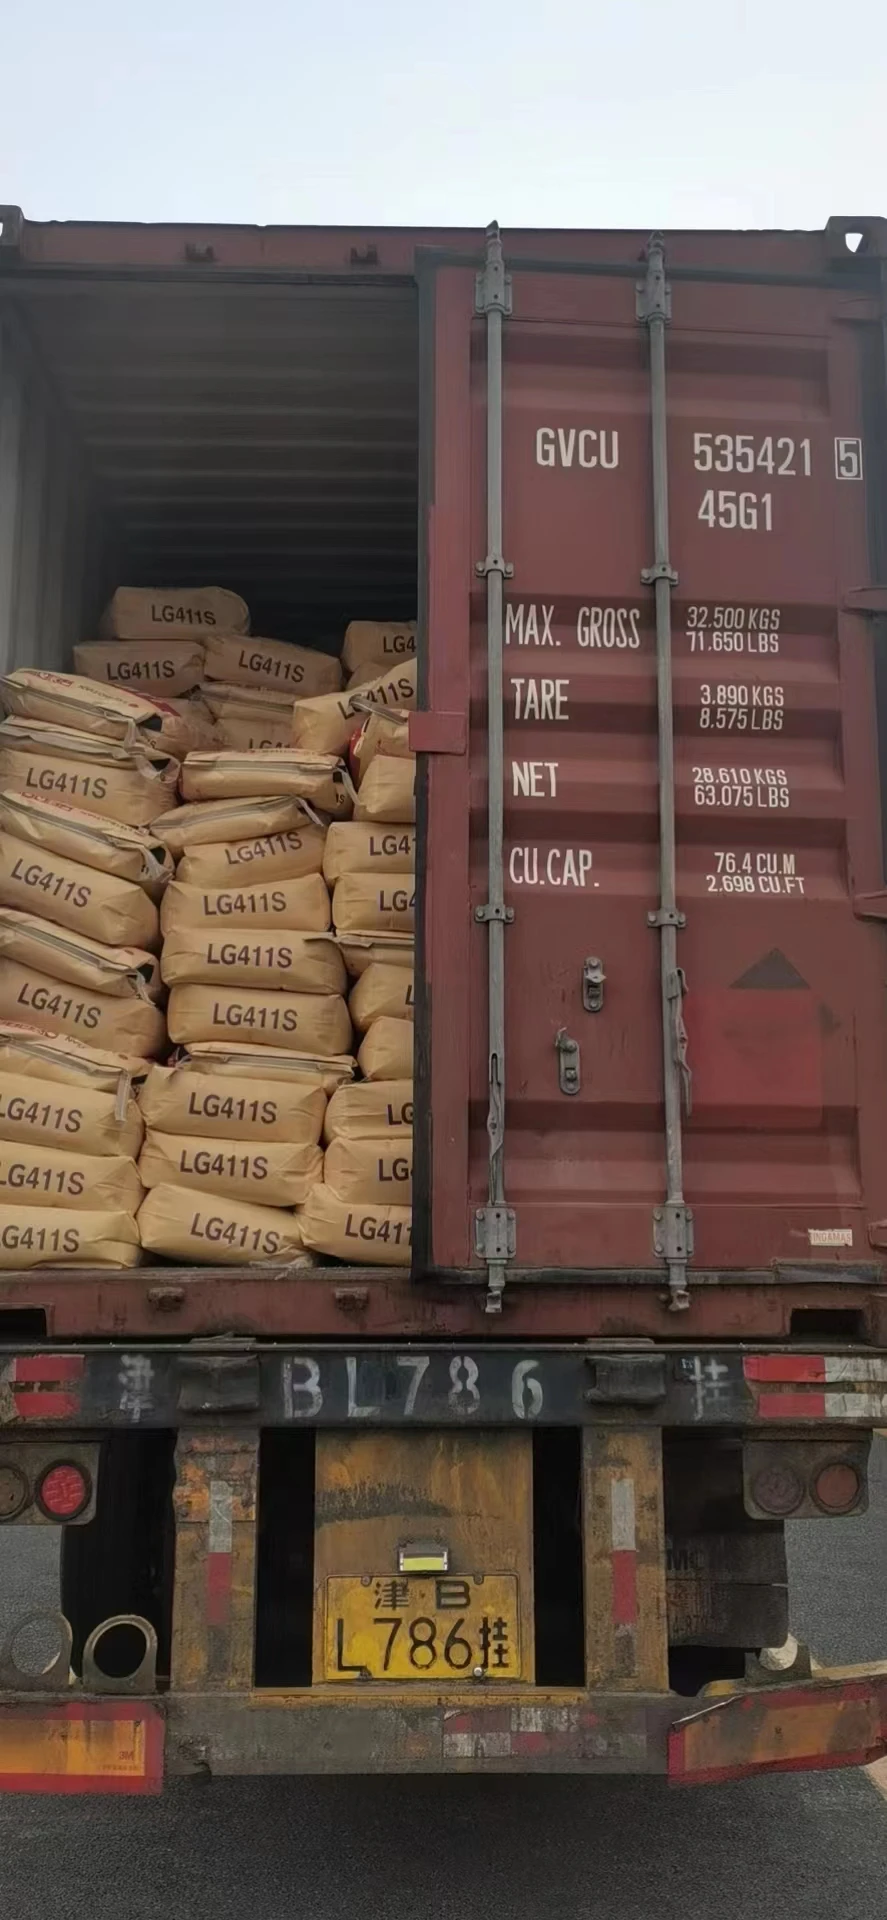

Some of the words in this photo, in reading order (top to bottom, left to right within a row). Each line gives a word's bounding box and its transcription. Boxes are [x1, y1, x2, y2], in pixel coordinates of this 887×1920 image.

[536, 427, 619, 469] GVCU
[693, 432, 812, 476] 535421
[839, 439, 860, 478] 5
[698, 490, 773, 531] 45G1
[151, 604, 217, 626] LG411S
[505, 603, 561, 646] MAX.
[577, 606, 640, 649] GROSS
[748, 608, 780, 630] KGS
[747, 632, 779, 653] LBS
[106, 660, 176, 681] LG411S
[238, 650, 305, 683] LG411S
[511, 678, 569, 720] TARE
[752, 685, 784, 707] KGS
[751, 708, 784, 730] LBS
[26, 767, 108, 799] LG411S
[512, 761, 558, 798] NET
[754, 768, 788, 785] KGS
[757, 786, 790, 808] LBS
[225, 832, 303, 865] LG411S
[369, 835, 416, 856] LG4
[714, 852, 752, 874] 76.4
[756, 853, 795, 875] CU.M
[10, 858, 92, 908] LG411S
[758, 876, 805, 894] CU.FT
[203, 892, 287, 915] LG411S
[207, 943, 293, 969] LG411S
[17, 983, 101, 1029] LG411S
[212, 1003, 298, 1032] LG411S
[188, 1092, 277, 1124] LG411S
[179, 1150, 269, 1180] LG411S
[378, 1158, 413, 1182] LG
[190, 1213, 281, 1254] LG411S
[337, 1616, 509, 1672] L786挂
